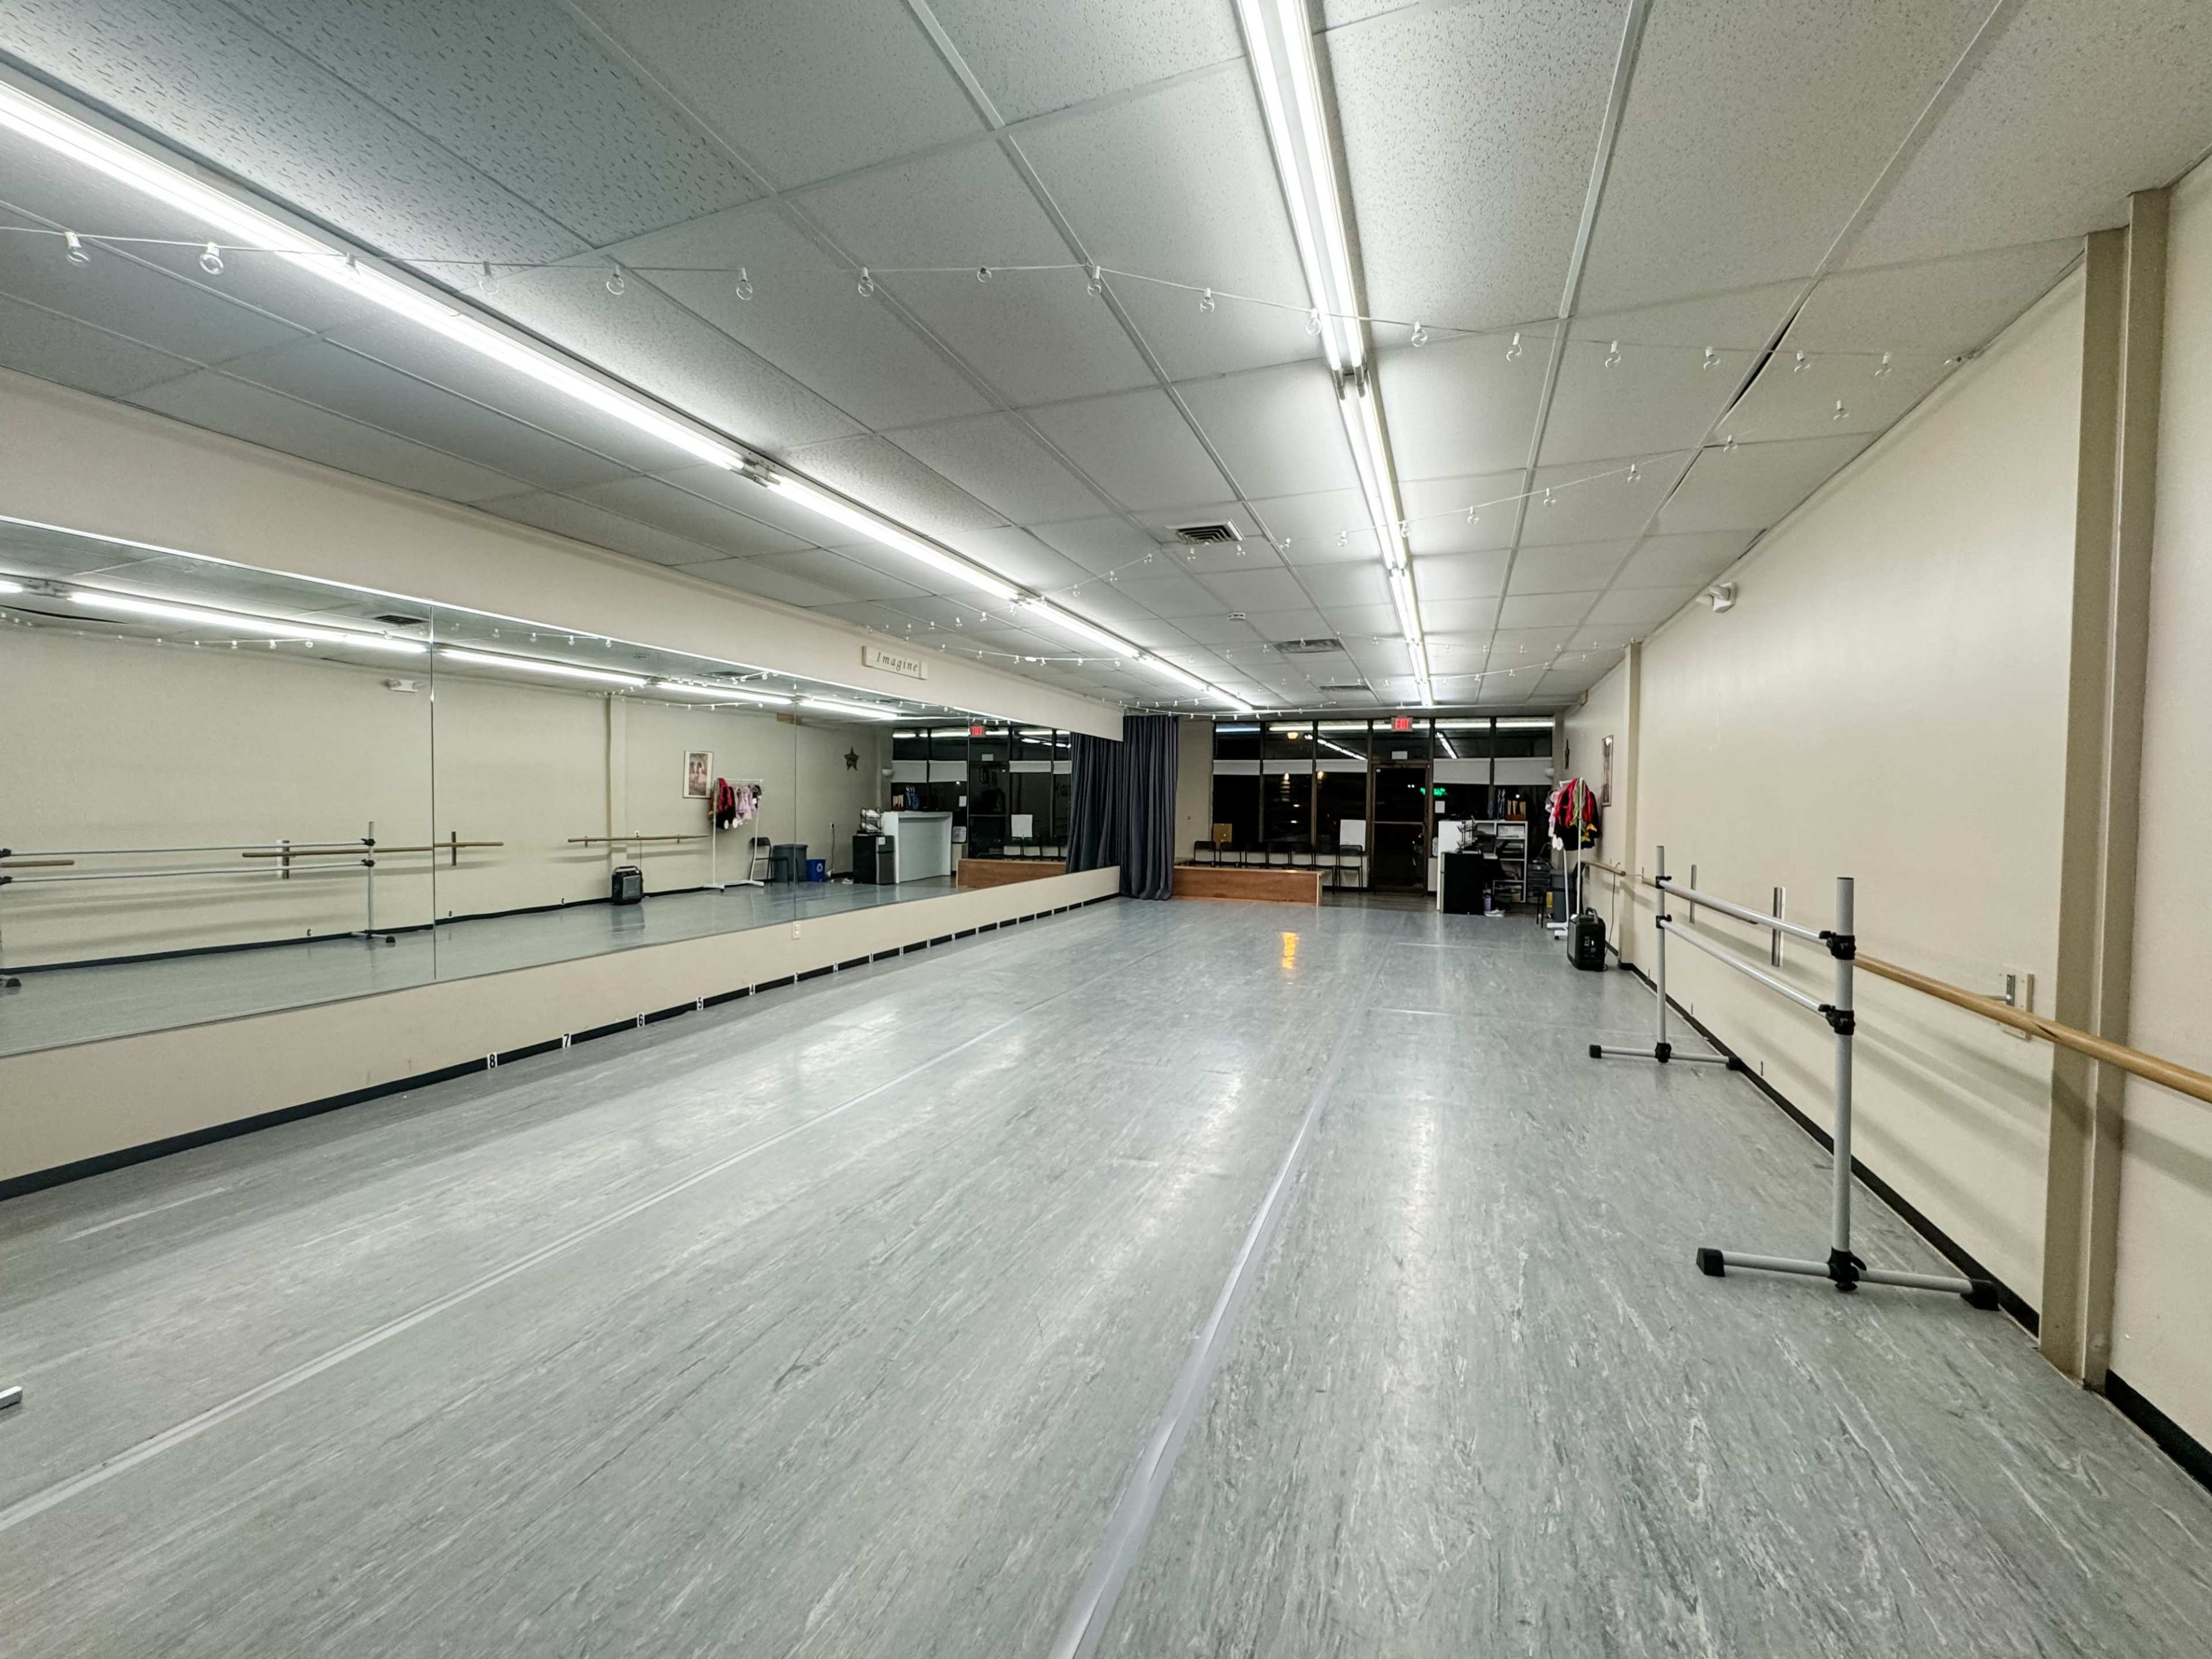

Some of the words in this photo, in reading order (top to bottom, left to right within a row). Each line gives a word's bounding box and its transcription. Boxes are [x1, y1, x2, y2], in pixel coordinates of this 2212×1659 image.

[876, 652, 918, 672] Imagine
[1396, 719, 1408, 729] EXIT
[751, 984, 754, 994] 4
[698, 997, 702, 1009] 5
[638, 1014, 643, 1027] 6
[563, 1033, 570, 1047] 7
[490, 1054, 496, 1068] 8
